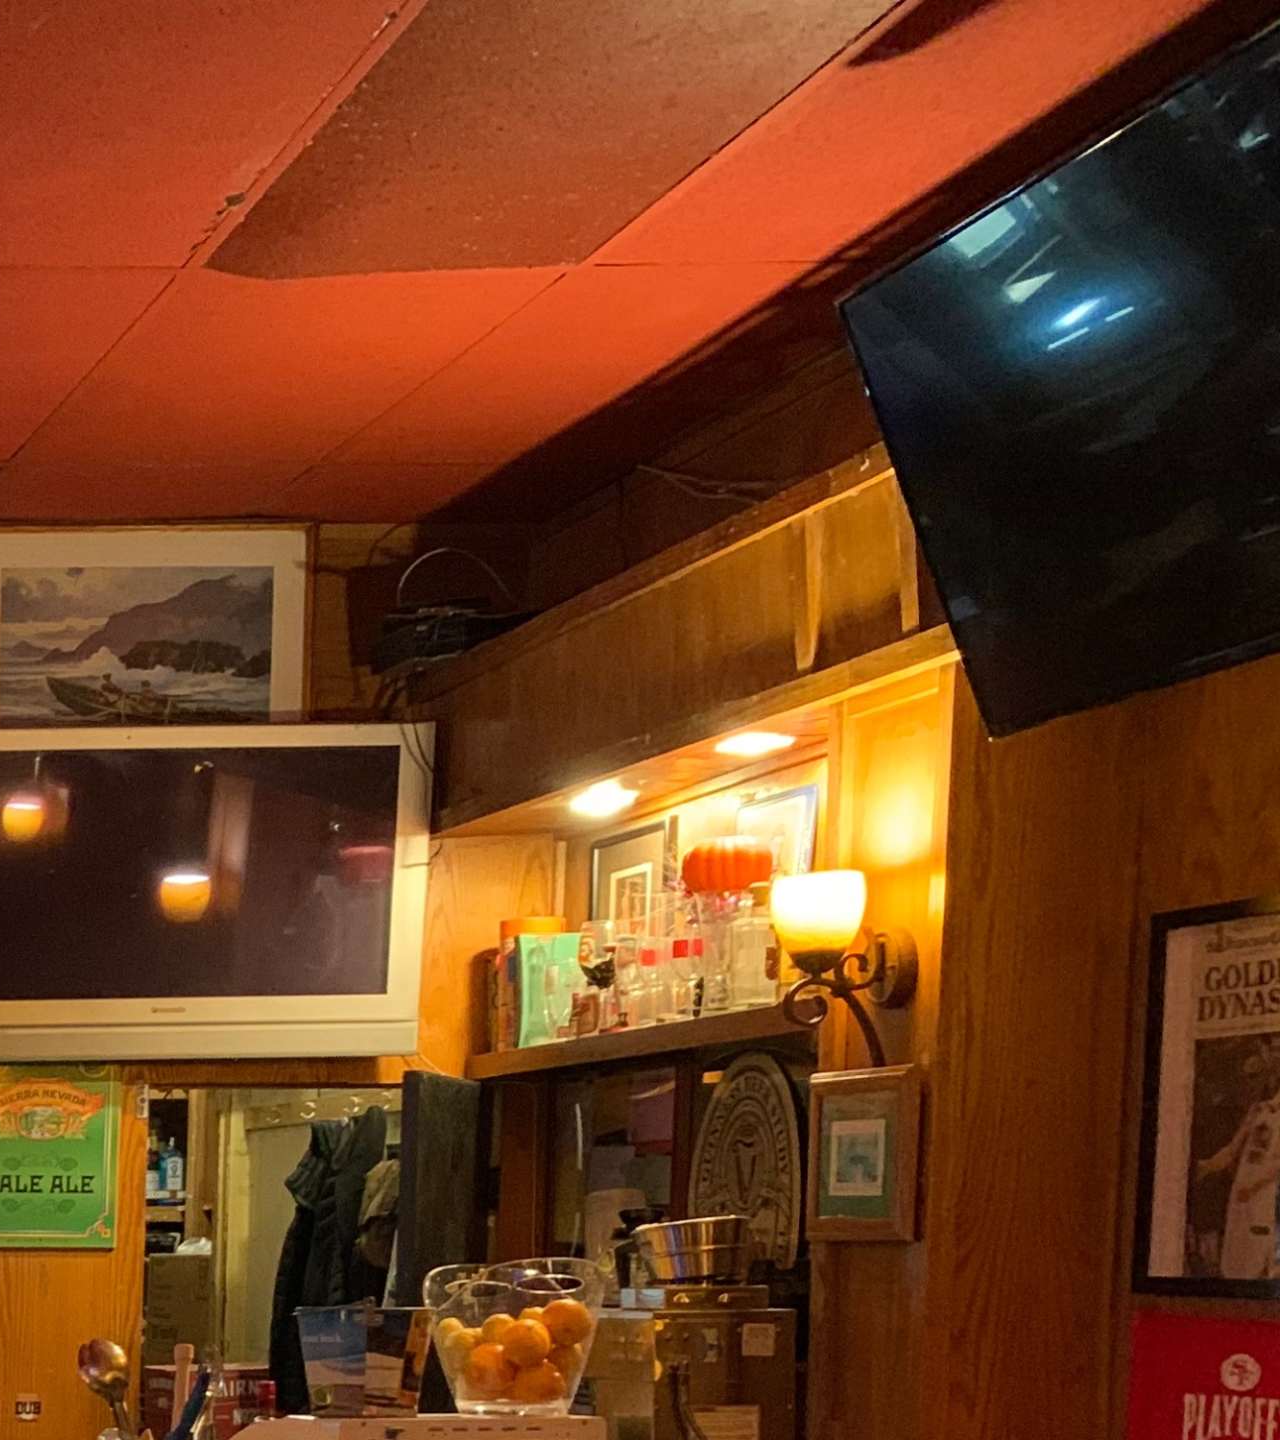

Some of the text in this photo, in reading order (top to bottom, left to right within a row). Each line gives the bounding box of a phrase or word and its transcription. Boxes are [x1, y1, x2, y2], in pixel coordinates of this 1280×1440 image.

[1204, 958, 1280, 992] GOLD
[42, 1087, 86, 1106] NEVADA
[49, 1174, 96, 1194] ALE
